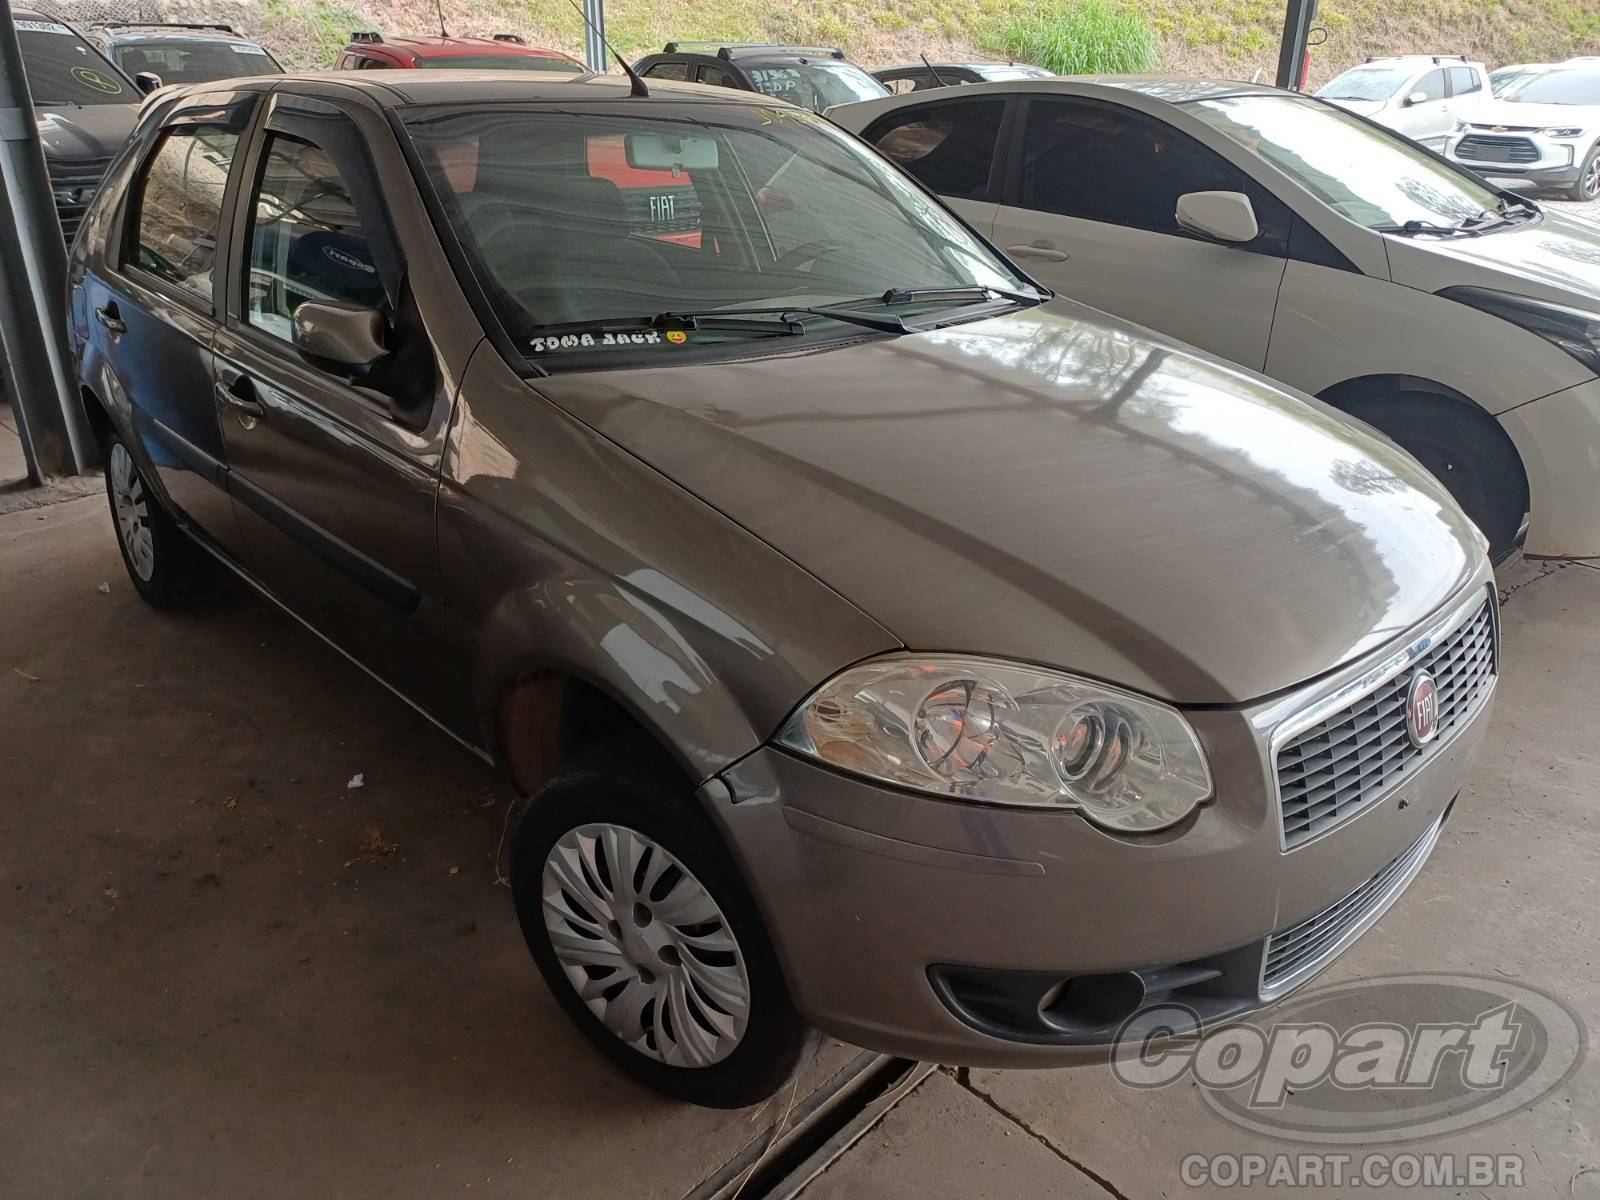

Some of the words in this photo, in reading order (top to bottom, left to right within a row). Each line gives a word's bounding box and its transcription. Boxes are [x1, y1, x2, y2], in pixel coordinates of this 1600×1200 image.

[650, 195, 675, 221] FIAT
[530, 332, 595, 352] TOMA
[602, 330, 661, 345] JACK
[1416, 693, 1433, 730] FIAT
